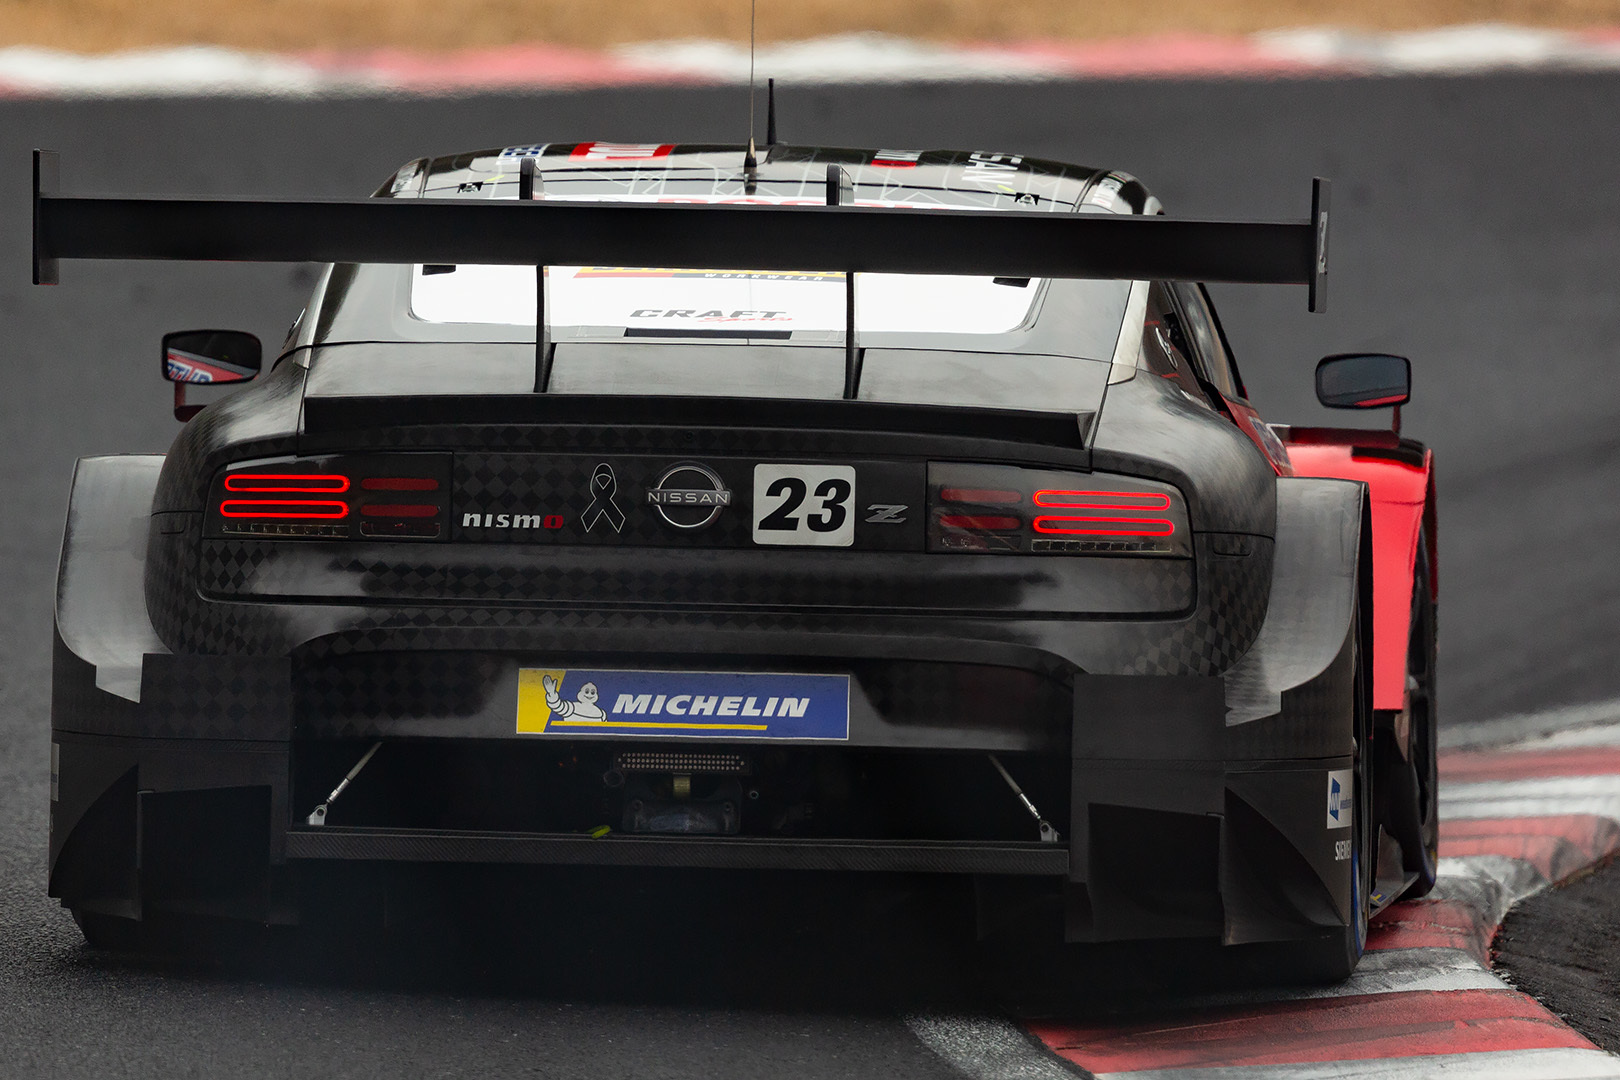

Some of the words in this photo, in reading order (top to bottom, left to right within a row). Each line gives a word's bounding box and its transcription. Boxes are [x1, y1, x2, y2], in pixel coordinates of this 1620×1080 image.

[704, 272, 824, 281] WORKWEAR
[630, 309, 786, 319] CRAFT
[648, 492, 729, 504] NISSAN
[758, 477, 851, 533] 23
[462, 512, 564, 529] nismo
[864, 504, 908, 524] Z
[611, 692, 810, 718] MICHELIN
